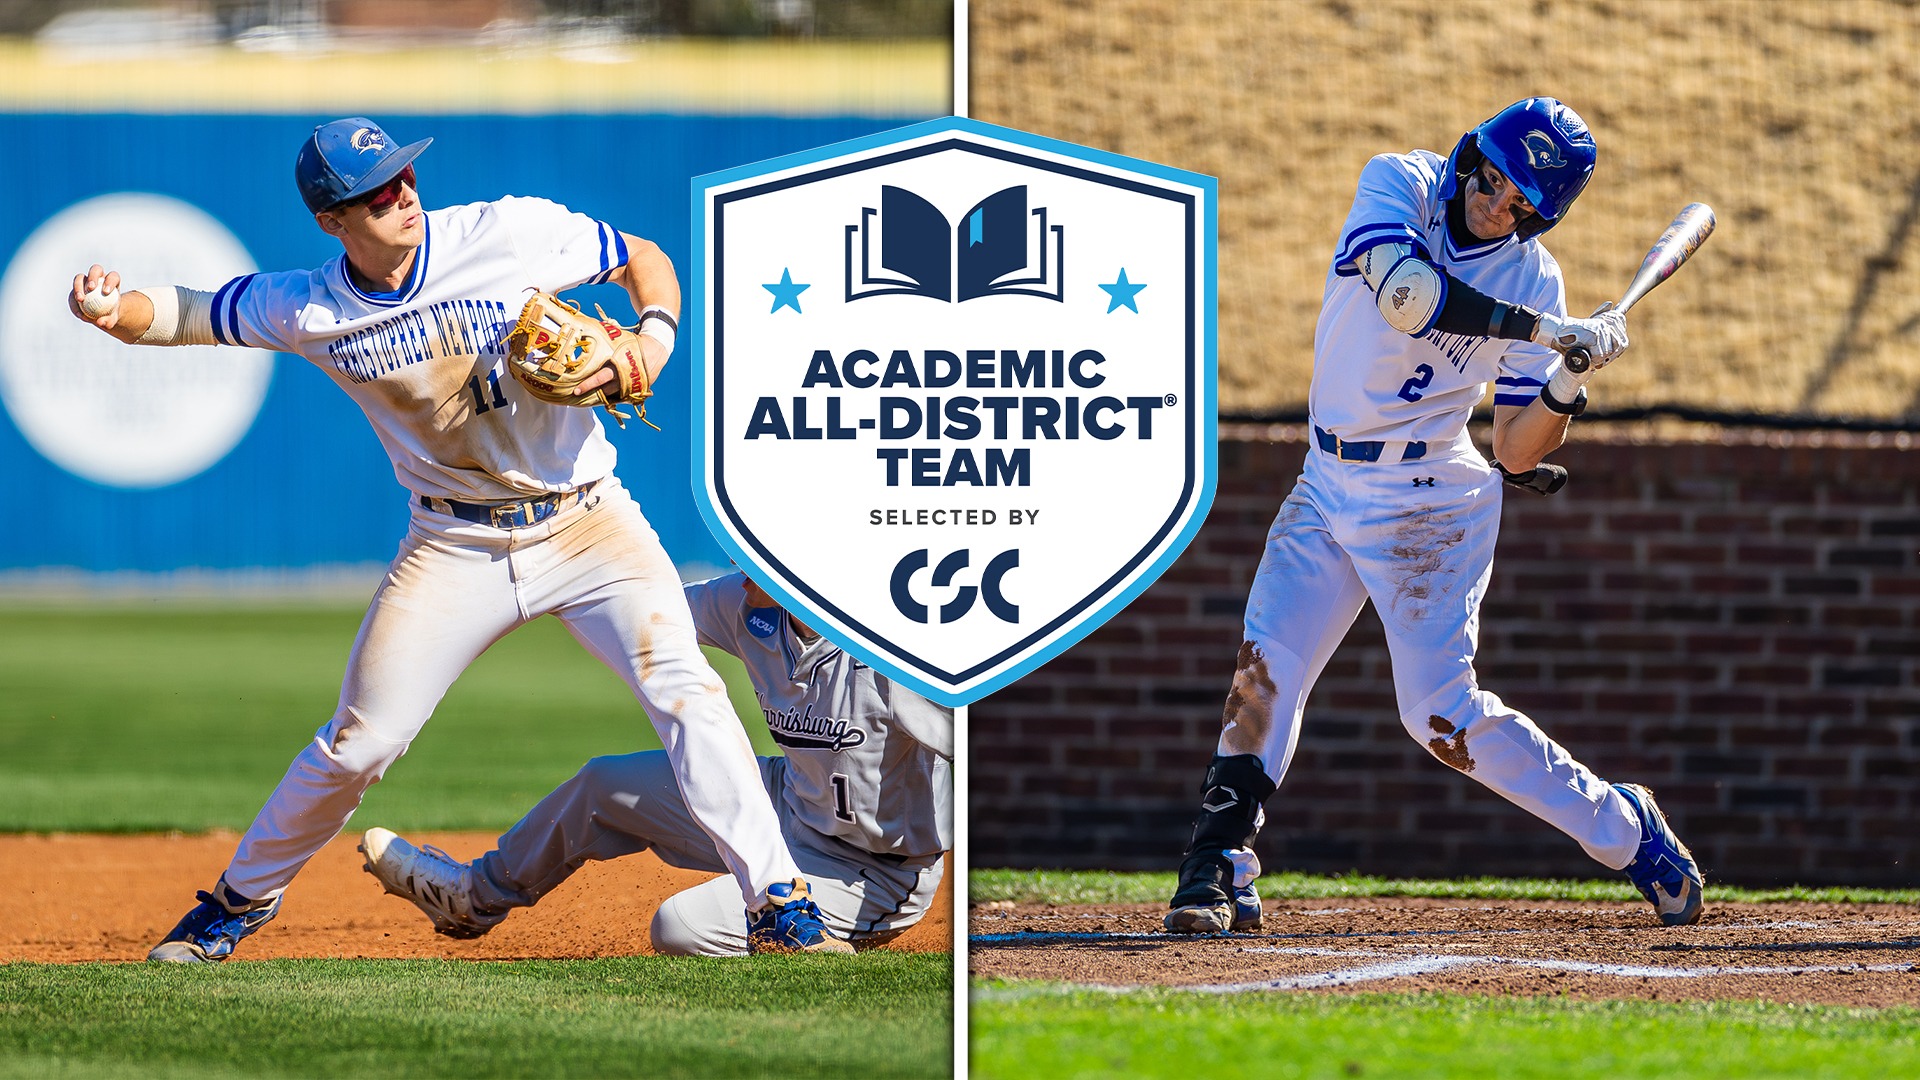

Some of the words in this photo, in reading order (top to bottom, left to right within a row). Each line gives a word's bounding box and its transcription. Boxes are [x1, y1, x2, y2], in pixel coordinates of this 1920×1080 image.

[328, 308, 434, 385] CHRISTOPHER
[429, 299, 512, 358] NEWPORT
[468, 369, 509, 416] 11
[520, 372, 555, 393] A2000
[624, 350, 643, 394] Wilson
[1397, 363, 1435, 403] 2
[750, 616, 775, 635] NCAA
[755, 690, 850, 751] arrisburg
[829, 773, 856, 824] 1
